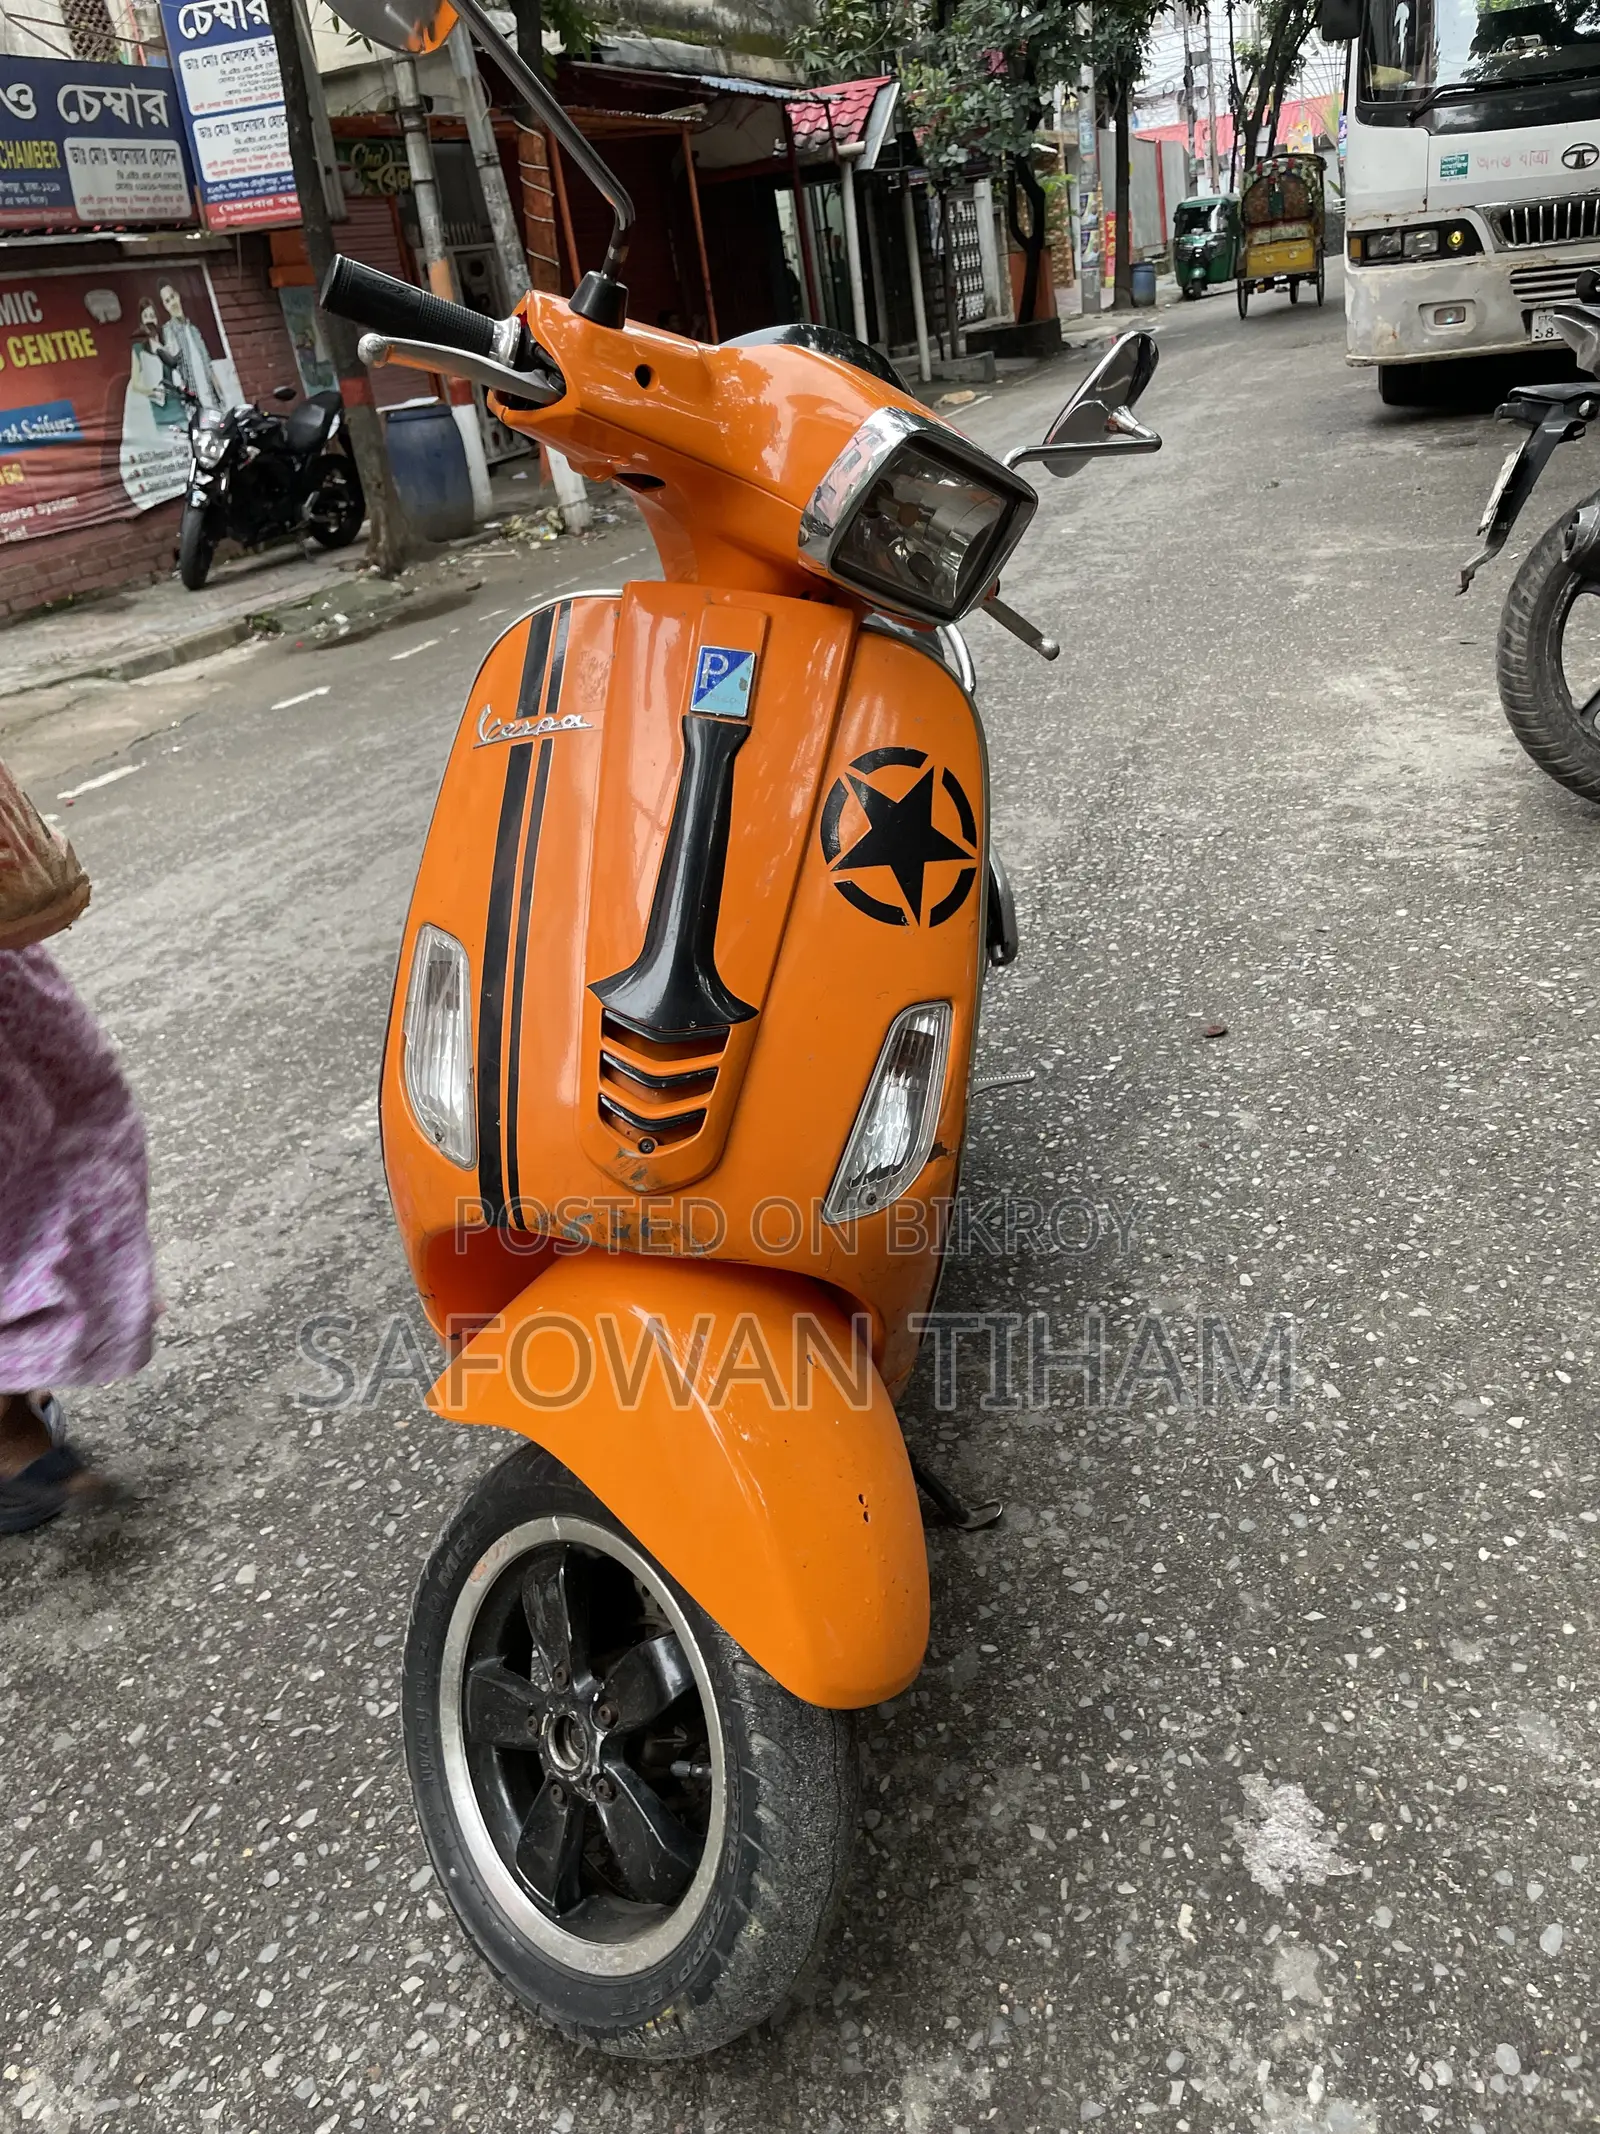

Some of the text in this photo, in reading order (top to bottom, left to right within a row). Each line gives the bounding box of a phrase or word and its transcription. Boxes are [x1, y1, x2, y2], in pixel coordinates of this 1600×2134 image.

[57, 82, 169, 129] চেম্বার
[0, 139, 62, 169] CHAMBER
[0, 290, 43, 326] MIC
[7, 328, 98, 368] CENTRE
[473, 703, 594, 749] Vespa
